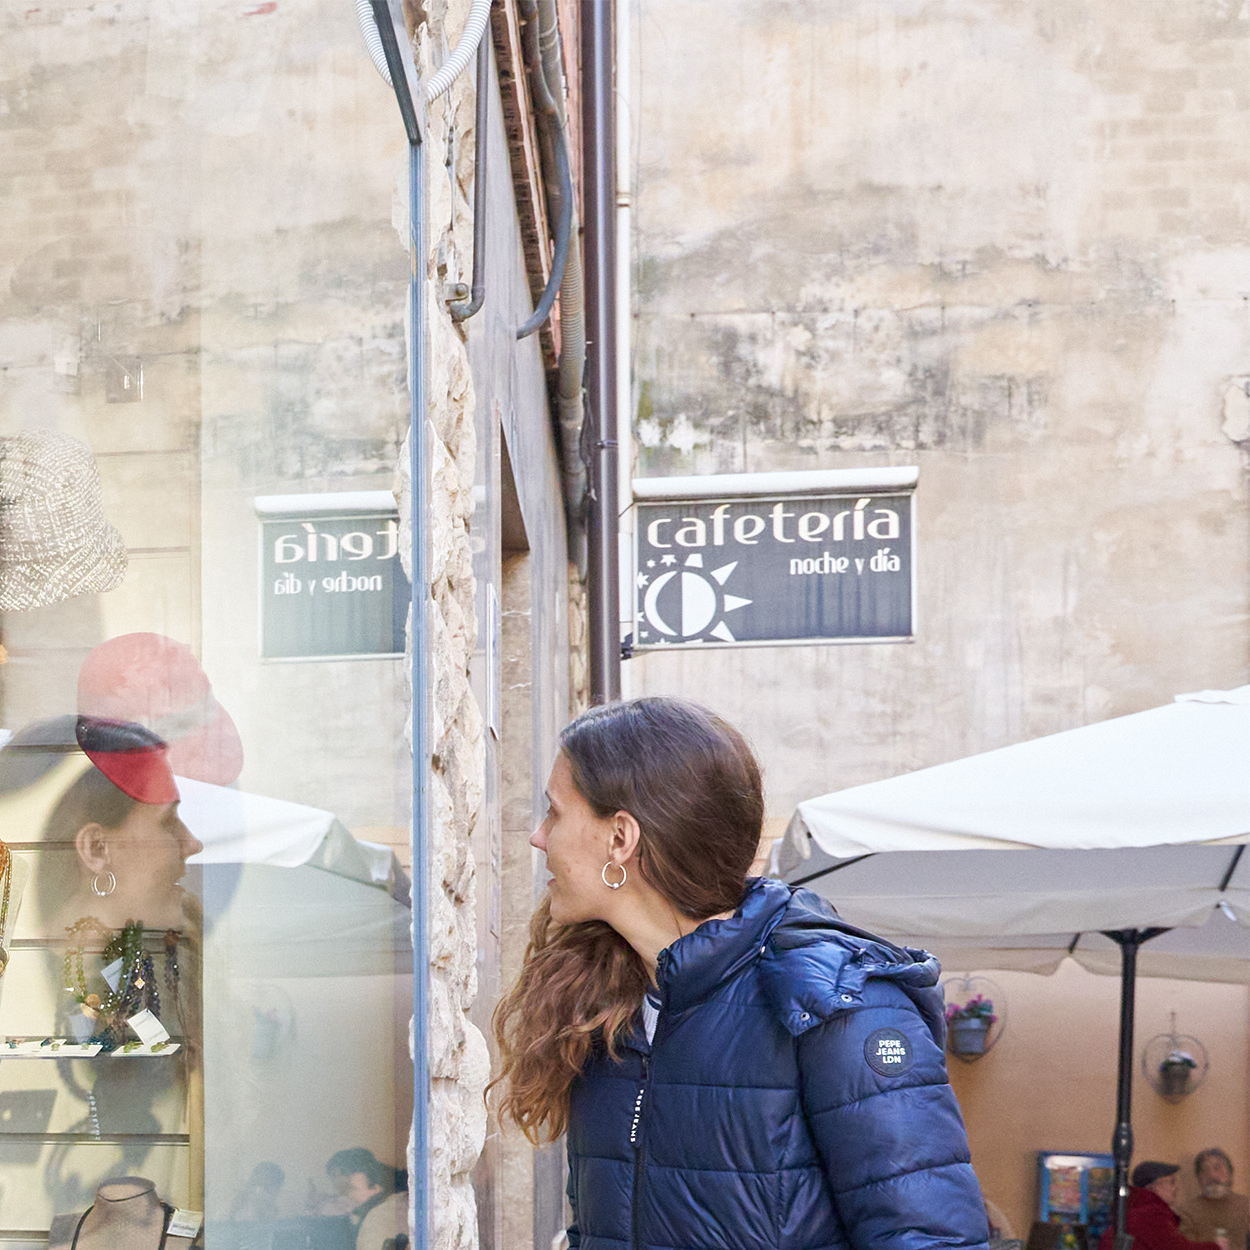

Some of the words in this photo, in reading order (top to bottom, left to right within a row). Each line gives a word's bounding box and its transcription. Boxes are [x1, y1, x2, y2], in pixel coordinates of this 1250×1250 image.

[647, 498, 900, 549] cafetería
[790, 551, 849, 575] noche
[855, 558, 865, 575] y
[870, 547, 900, 572] día
[878, 1040, 901, 1048] PEPE
[875, 1047, 906, 1056] JEANS
[882, 1055, 902, 1064] LDN
